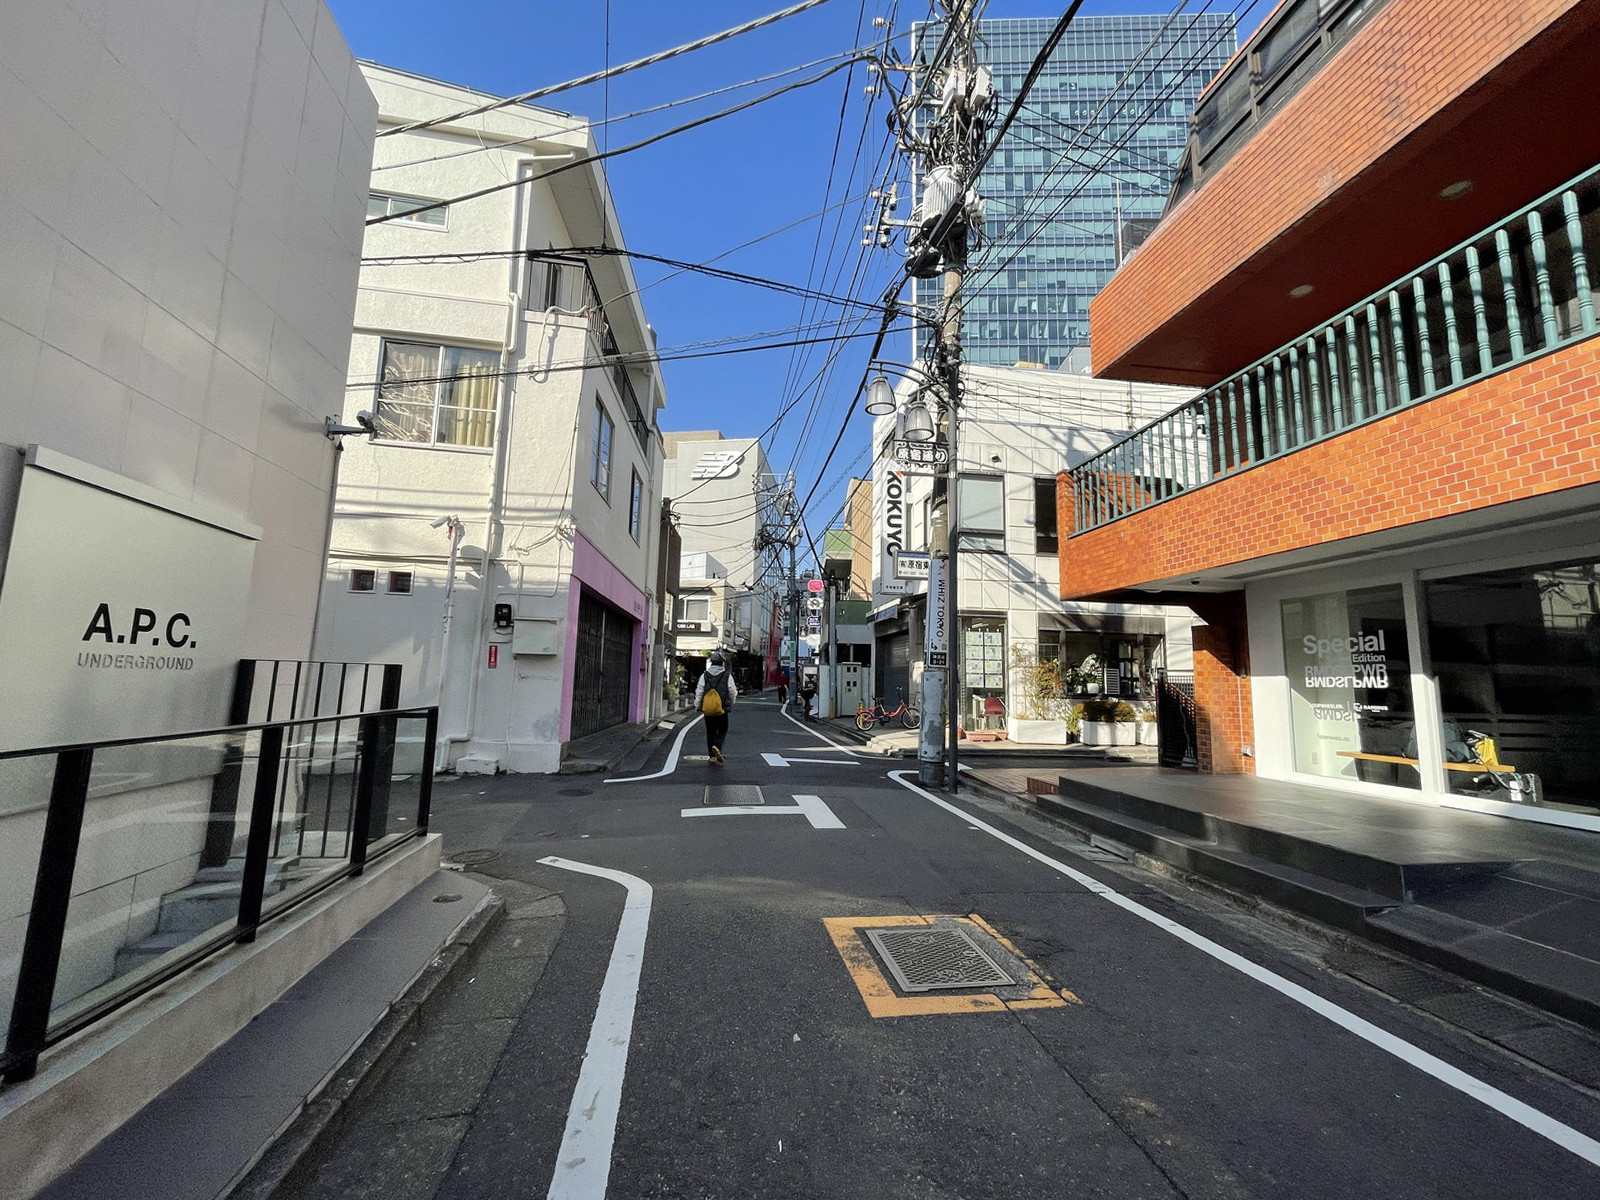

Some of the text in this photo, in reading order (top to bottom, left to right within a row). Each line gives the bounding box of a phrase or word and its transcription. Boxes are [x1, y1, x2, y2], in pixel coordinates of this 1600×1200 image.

[898, 447, 946, 463] 原宿通り
[937, 579, 946, 603] WHIZ
[82, 602, 197, 649] A.P.C.
[1303, 629, 1385, 658] Special
[77, 652, 194, 671] UNDERGROUND
[1352, 653, 1386, 663] Edition
